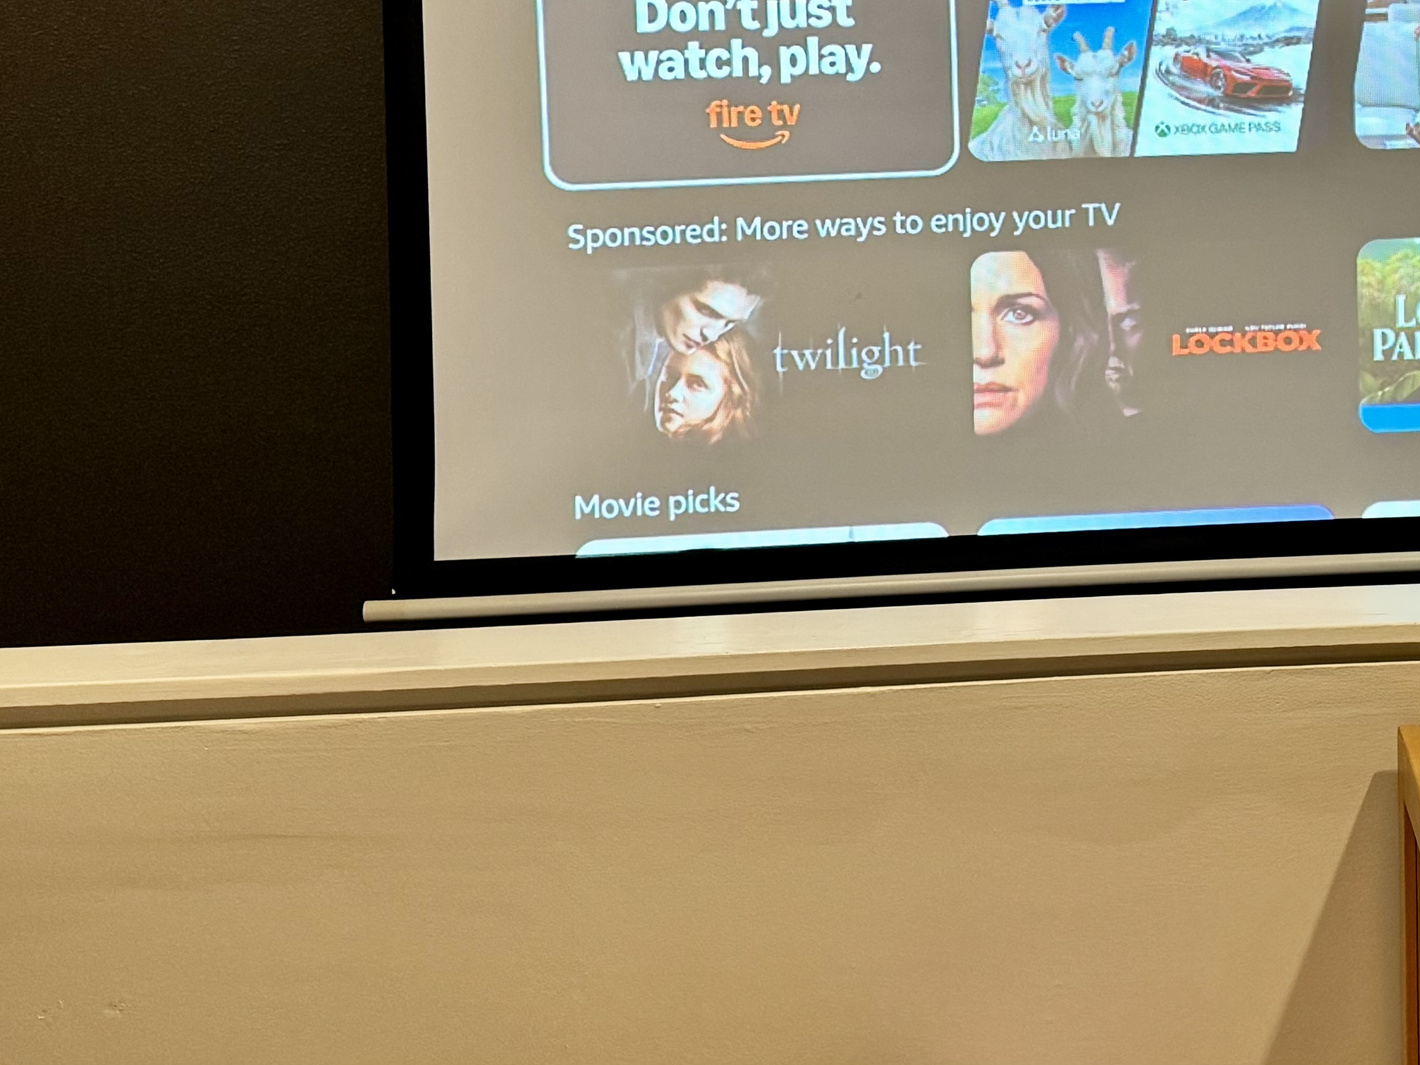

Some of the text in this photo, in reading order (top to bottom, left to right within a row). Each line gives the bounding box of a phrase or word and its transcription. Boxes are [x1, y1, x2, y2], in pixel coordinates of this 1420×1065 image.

[618, 36, 882, 84] watch, play.
[706, 99, 801, 128] fire tv
[1173, 121, 1282, 135] XBOX GAME PASS
[567, 202, 1121, 254] Sponsored: More ways to enjoy your TV
[773, 326, 925, 380] twilight
[1172, 329, 1322, 356] LOCKBOX
[574, 485, 740, 521] Movie picks
